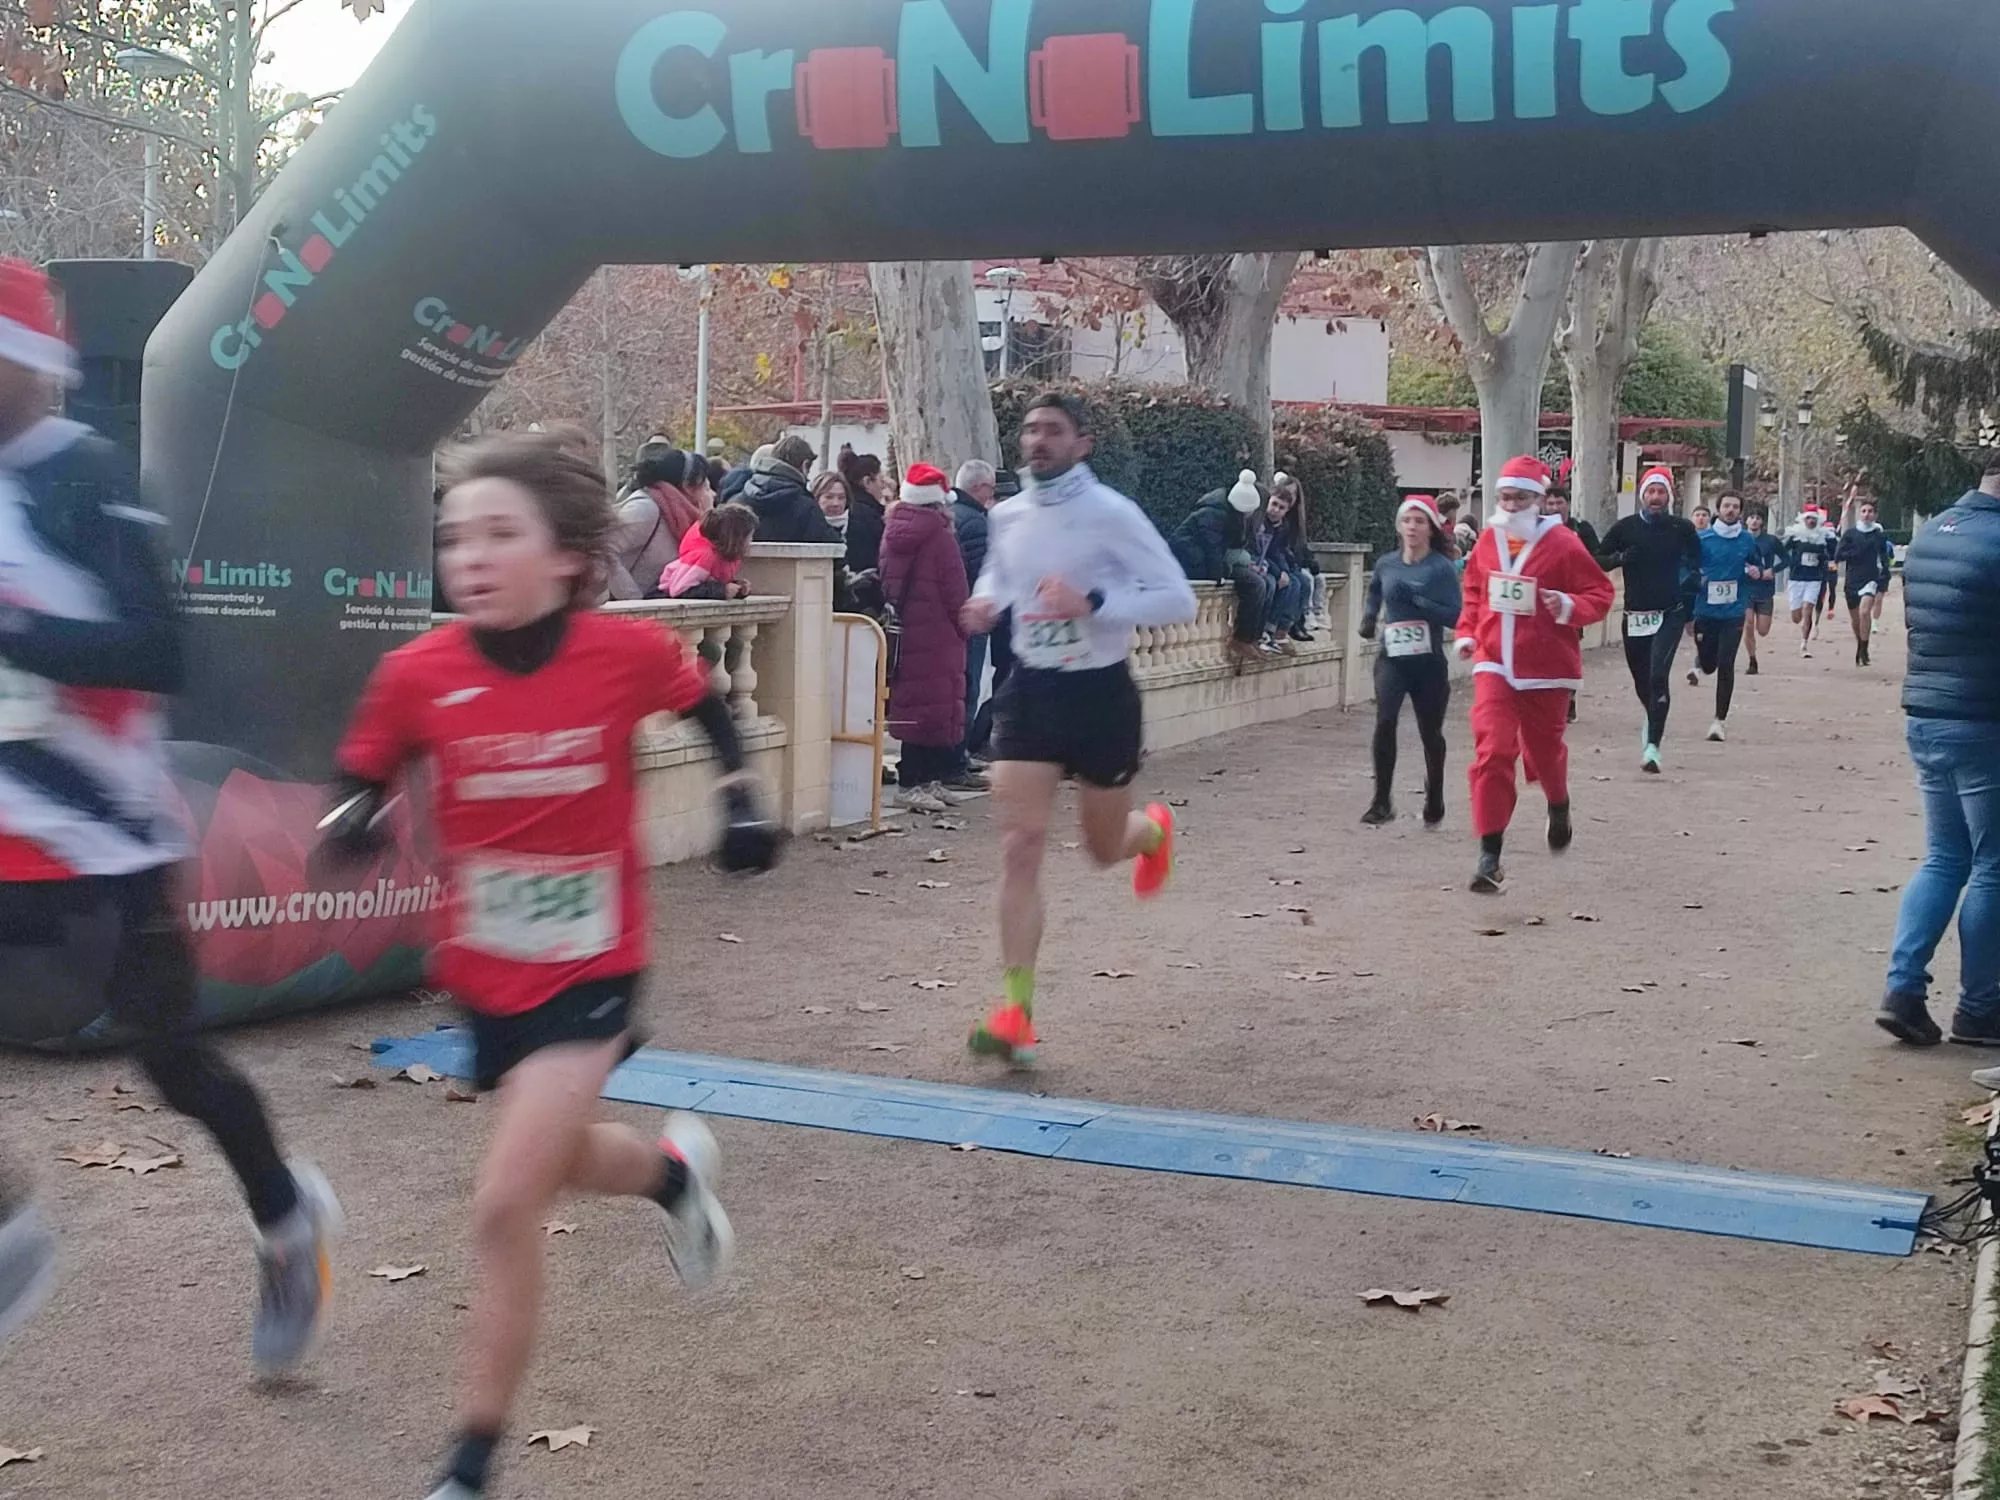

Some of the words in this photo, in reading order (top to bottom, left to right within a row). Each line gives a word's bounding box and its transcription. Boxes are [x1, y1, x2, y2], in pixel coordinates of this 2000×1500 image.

[1499, 580, 1524, 601] 16
[1715, 584, 1732, 597] 93
[256, 594, 265, 605] y
[219, 605, 277, 617] deportivos
[344, 602, 383, 615] Servicio
[383, 605, 395, 617] de
[339, 618, 377, 631] gestión
[377, 620, 390, 631] de
[1392, 625, 1426, 644] 239
